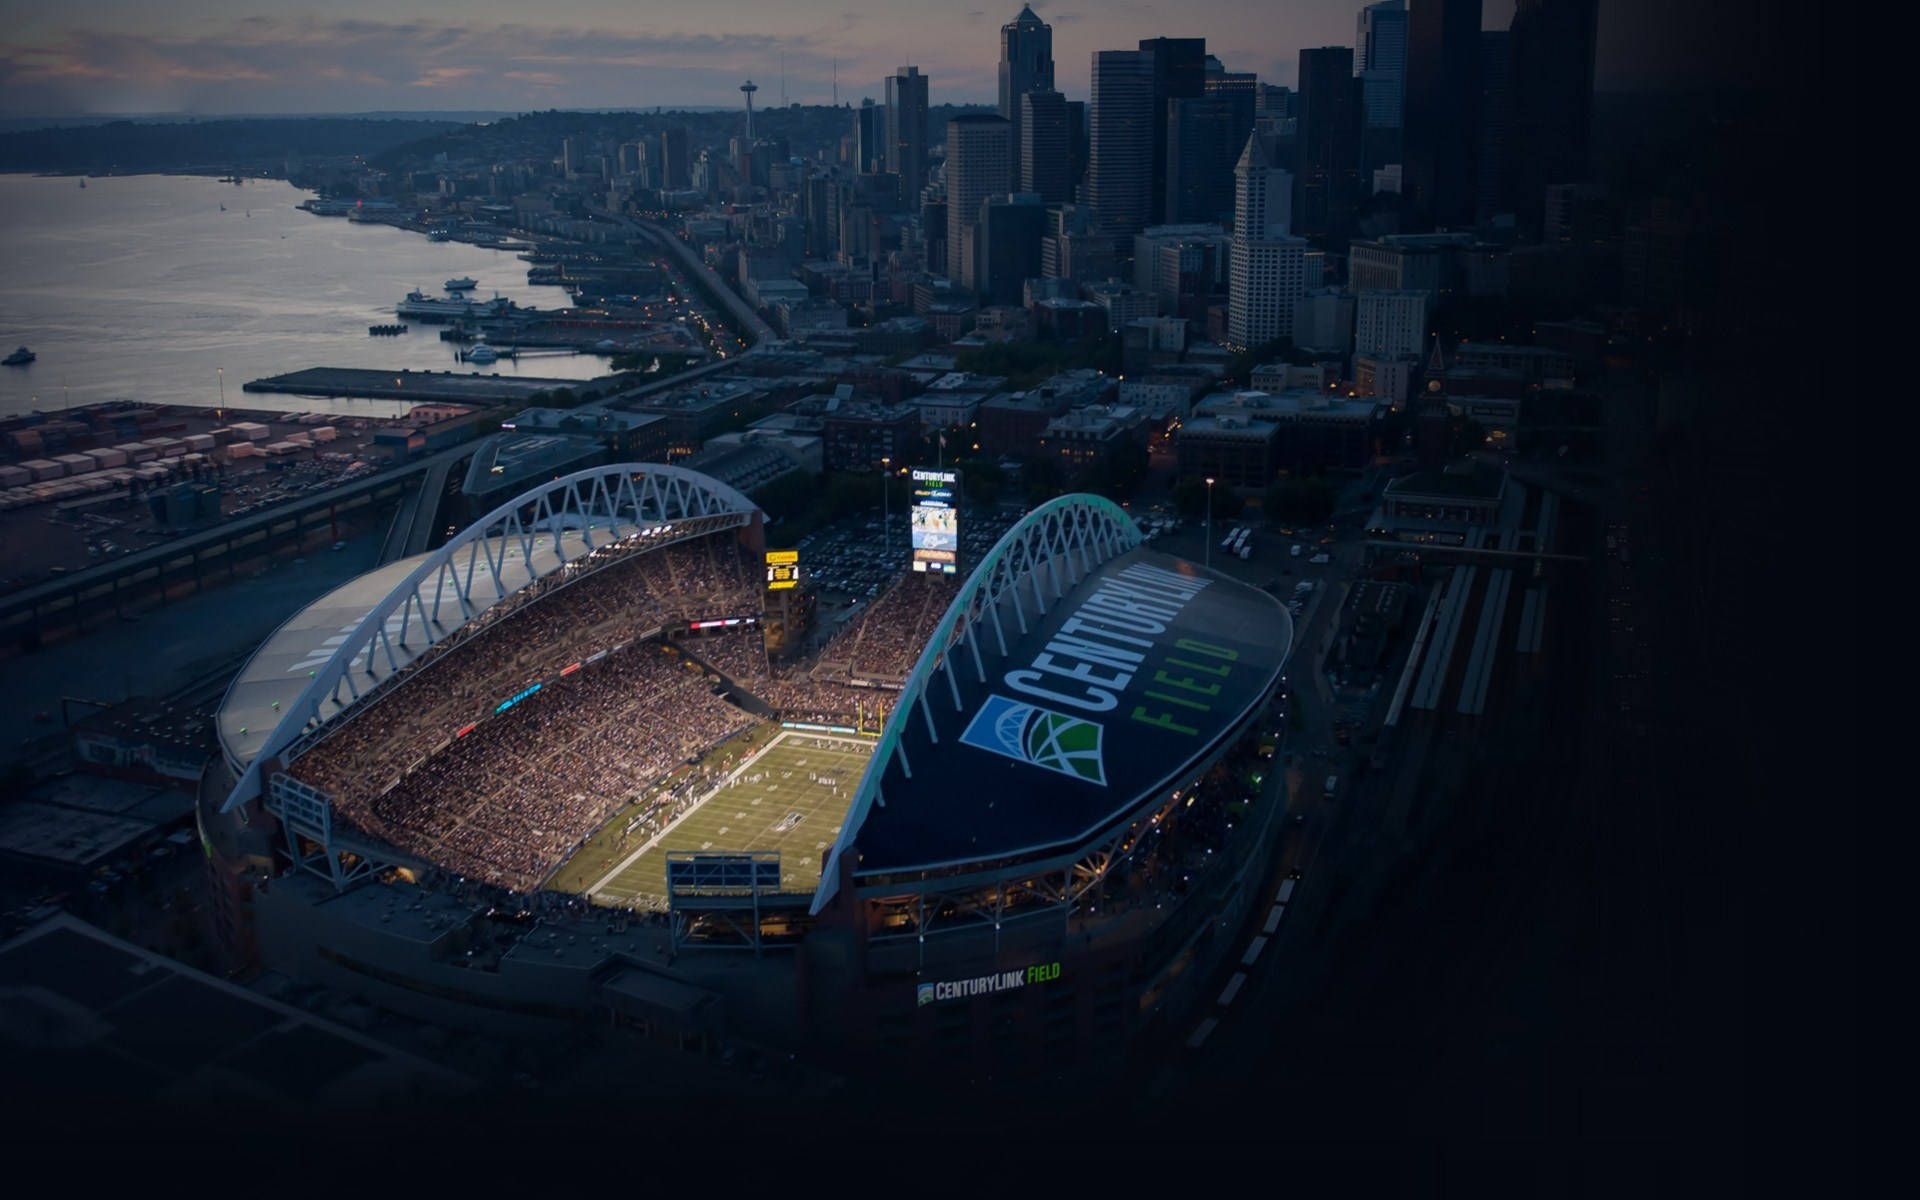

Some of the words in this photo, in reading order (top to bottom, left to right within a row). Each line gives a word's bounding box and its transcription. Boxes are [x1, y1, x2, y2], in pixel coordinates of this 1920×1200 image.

[913, 470, 955, 482] CENTURYLINK
[1004, 562, 1214, 711] CENTURYLINK
[1131, 638, 1238, 735] FIELD
[936, 970, 1024, 1000] CENTURYLINK
[1027, 962, 1060, 984] FIELD
